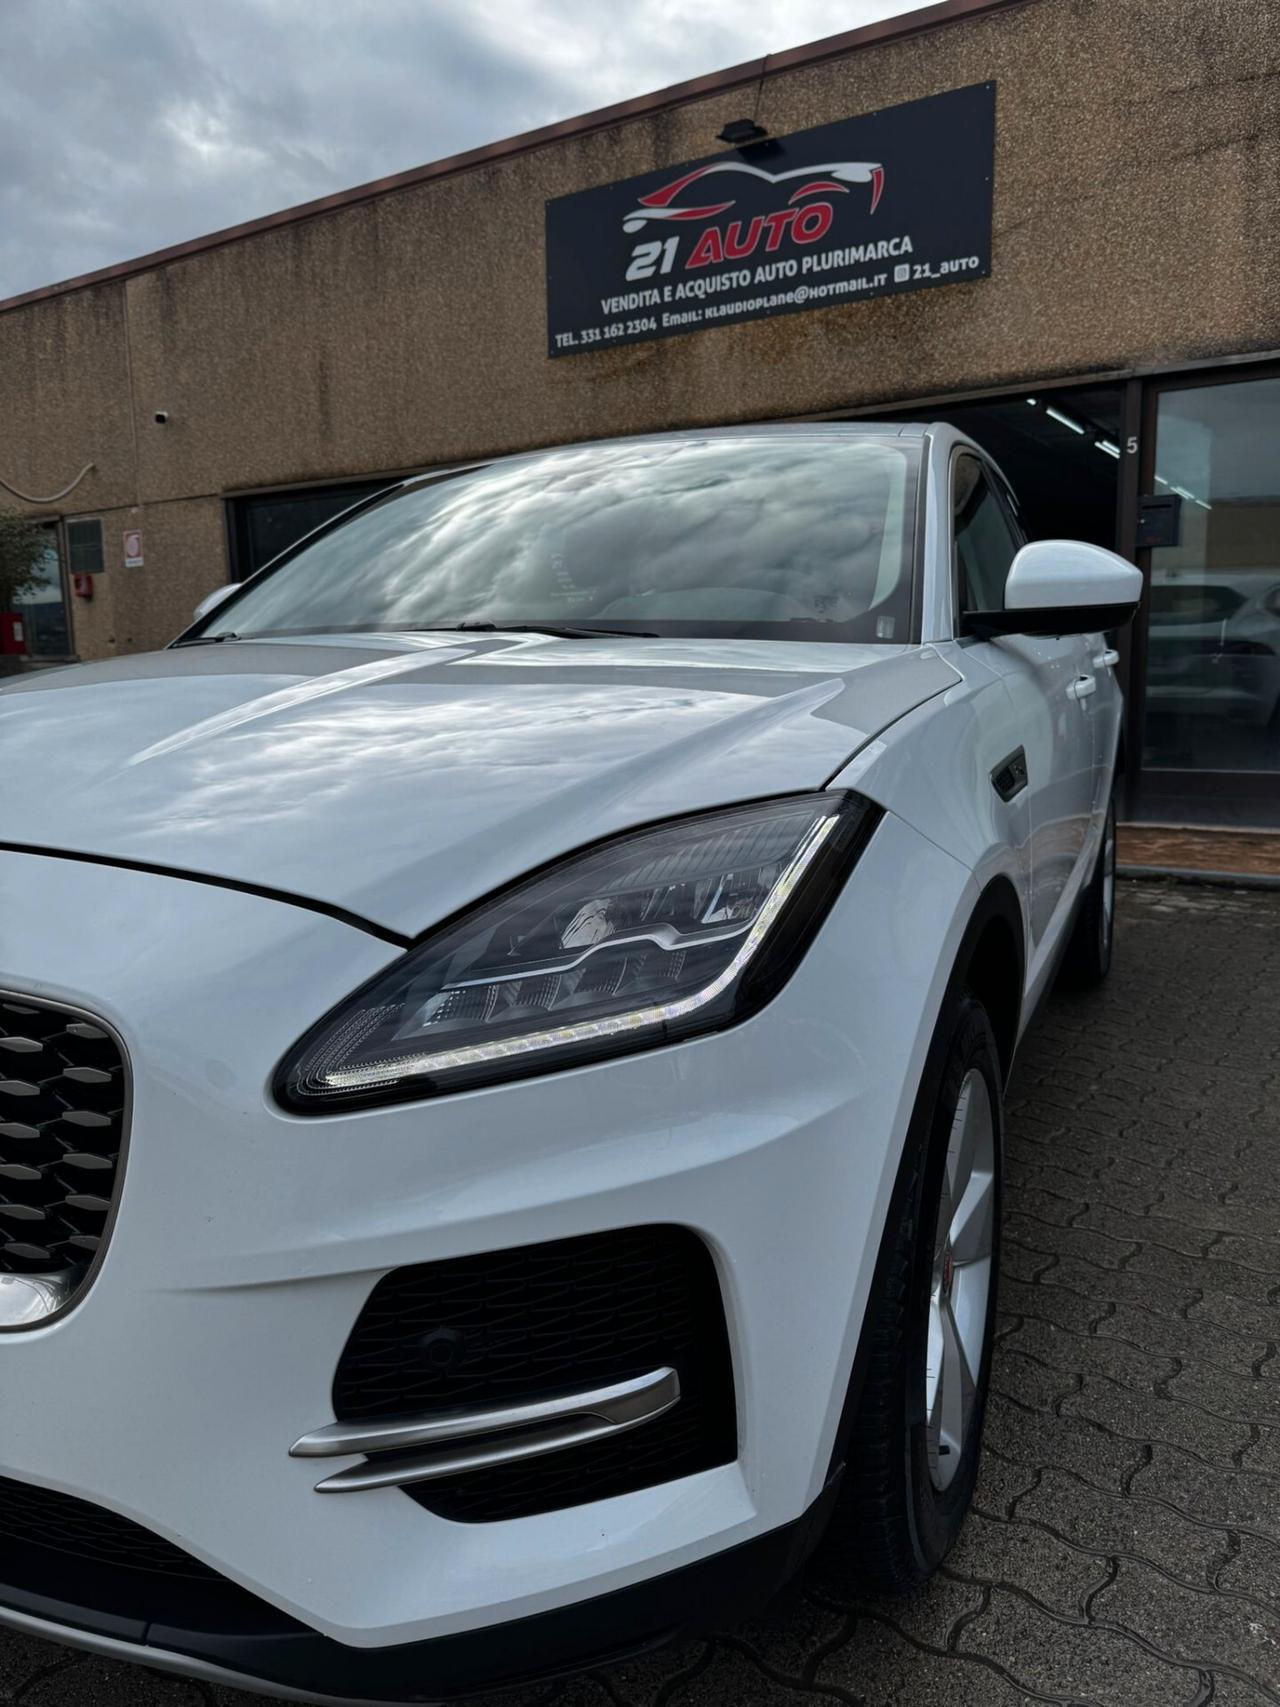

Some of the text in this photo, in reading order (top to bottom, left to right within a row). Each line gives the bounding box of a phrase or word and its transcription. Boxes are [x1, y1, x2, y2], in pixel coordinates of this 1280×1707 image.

[626, 201, 834, 282] 21 AUTO
[601, 235, 913, 315] VENDITA E ACQUISTO AUTO PLURIMARCA
[555, 331, 579, 348] TEL.
[580, 327, 602, 345] 331
[603, 322, 625, 339] 162
[626, 317, 658, 335] 2304
[1126, 436, 1138, 454] 5
